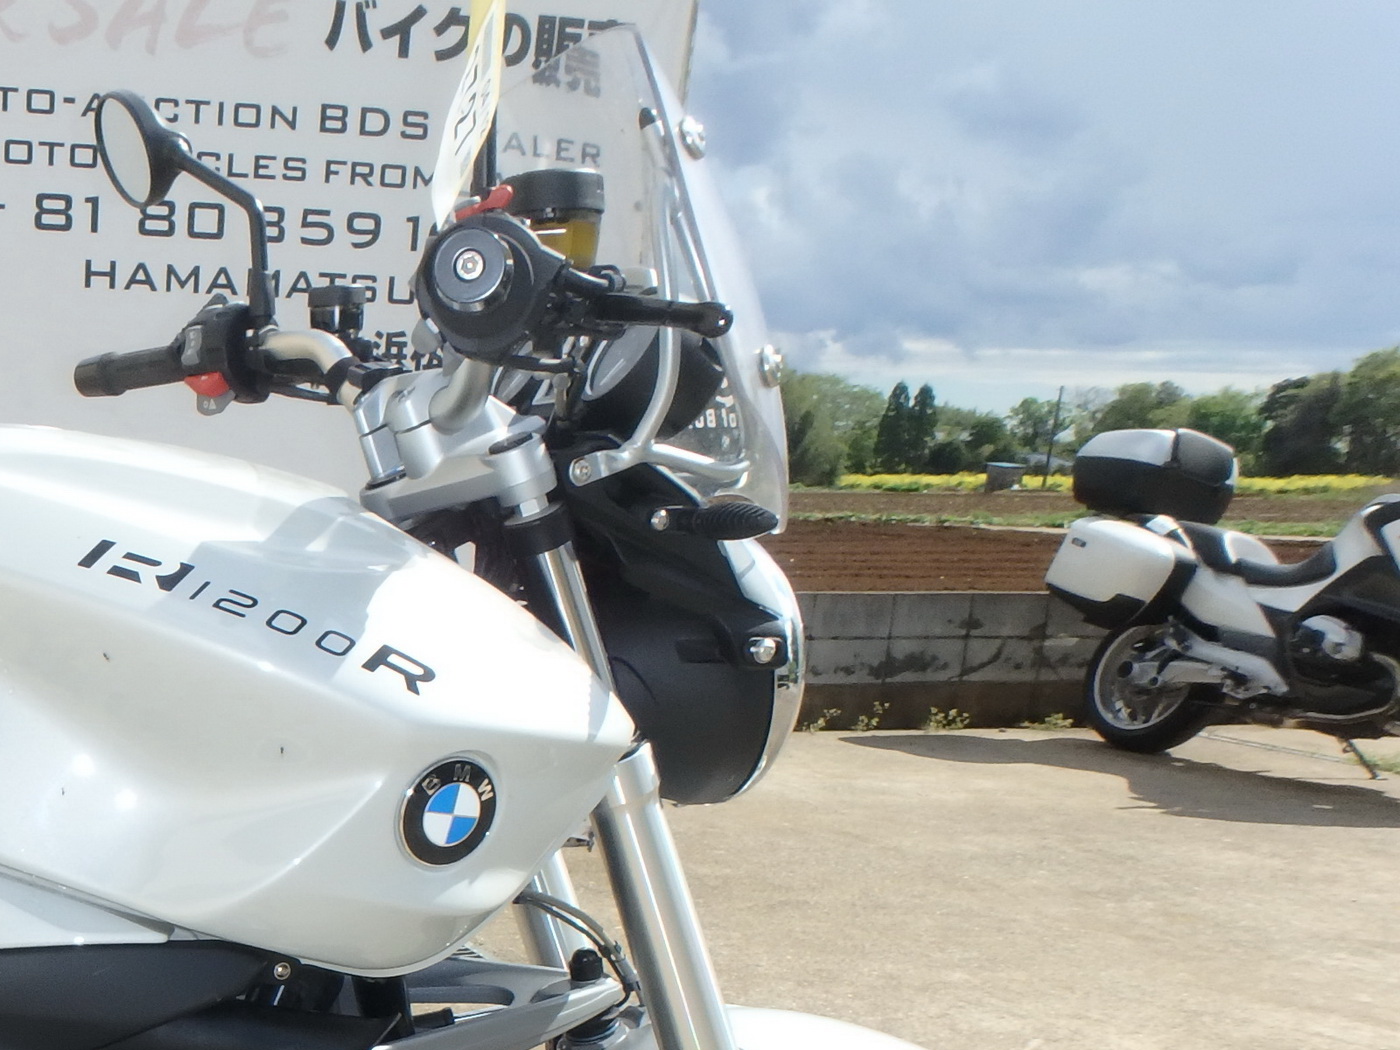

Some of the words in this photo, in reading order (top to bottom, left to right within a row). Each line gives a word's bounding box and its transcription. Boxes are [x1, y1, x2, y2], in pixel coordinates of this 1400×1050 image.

[319, 103, 429, 140] BDS
[34, 192, 100, 234] 81
[138, 200, 226, 240] 80
[422, 763, 495, 803] BMW
